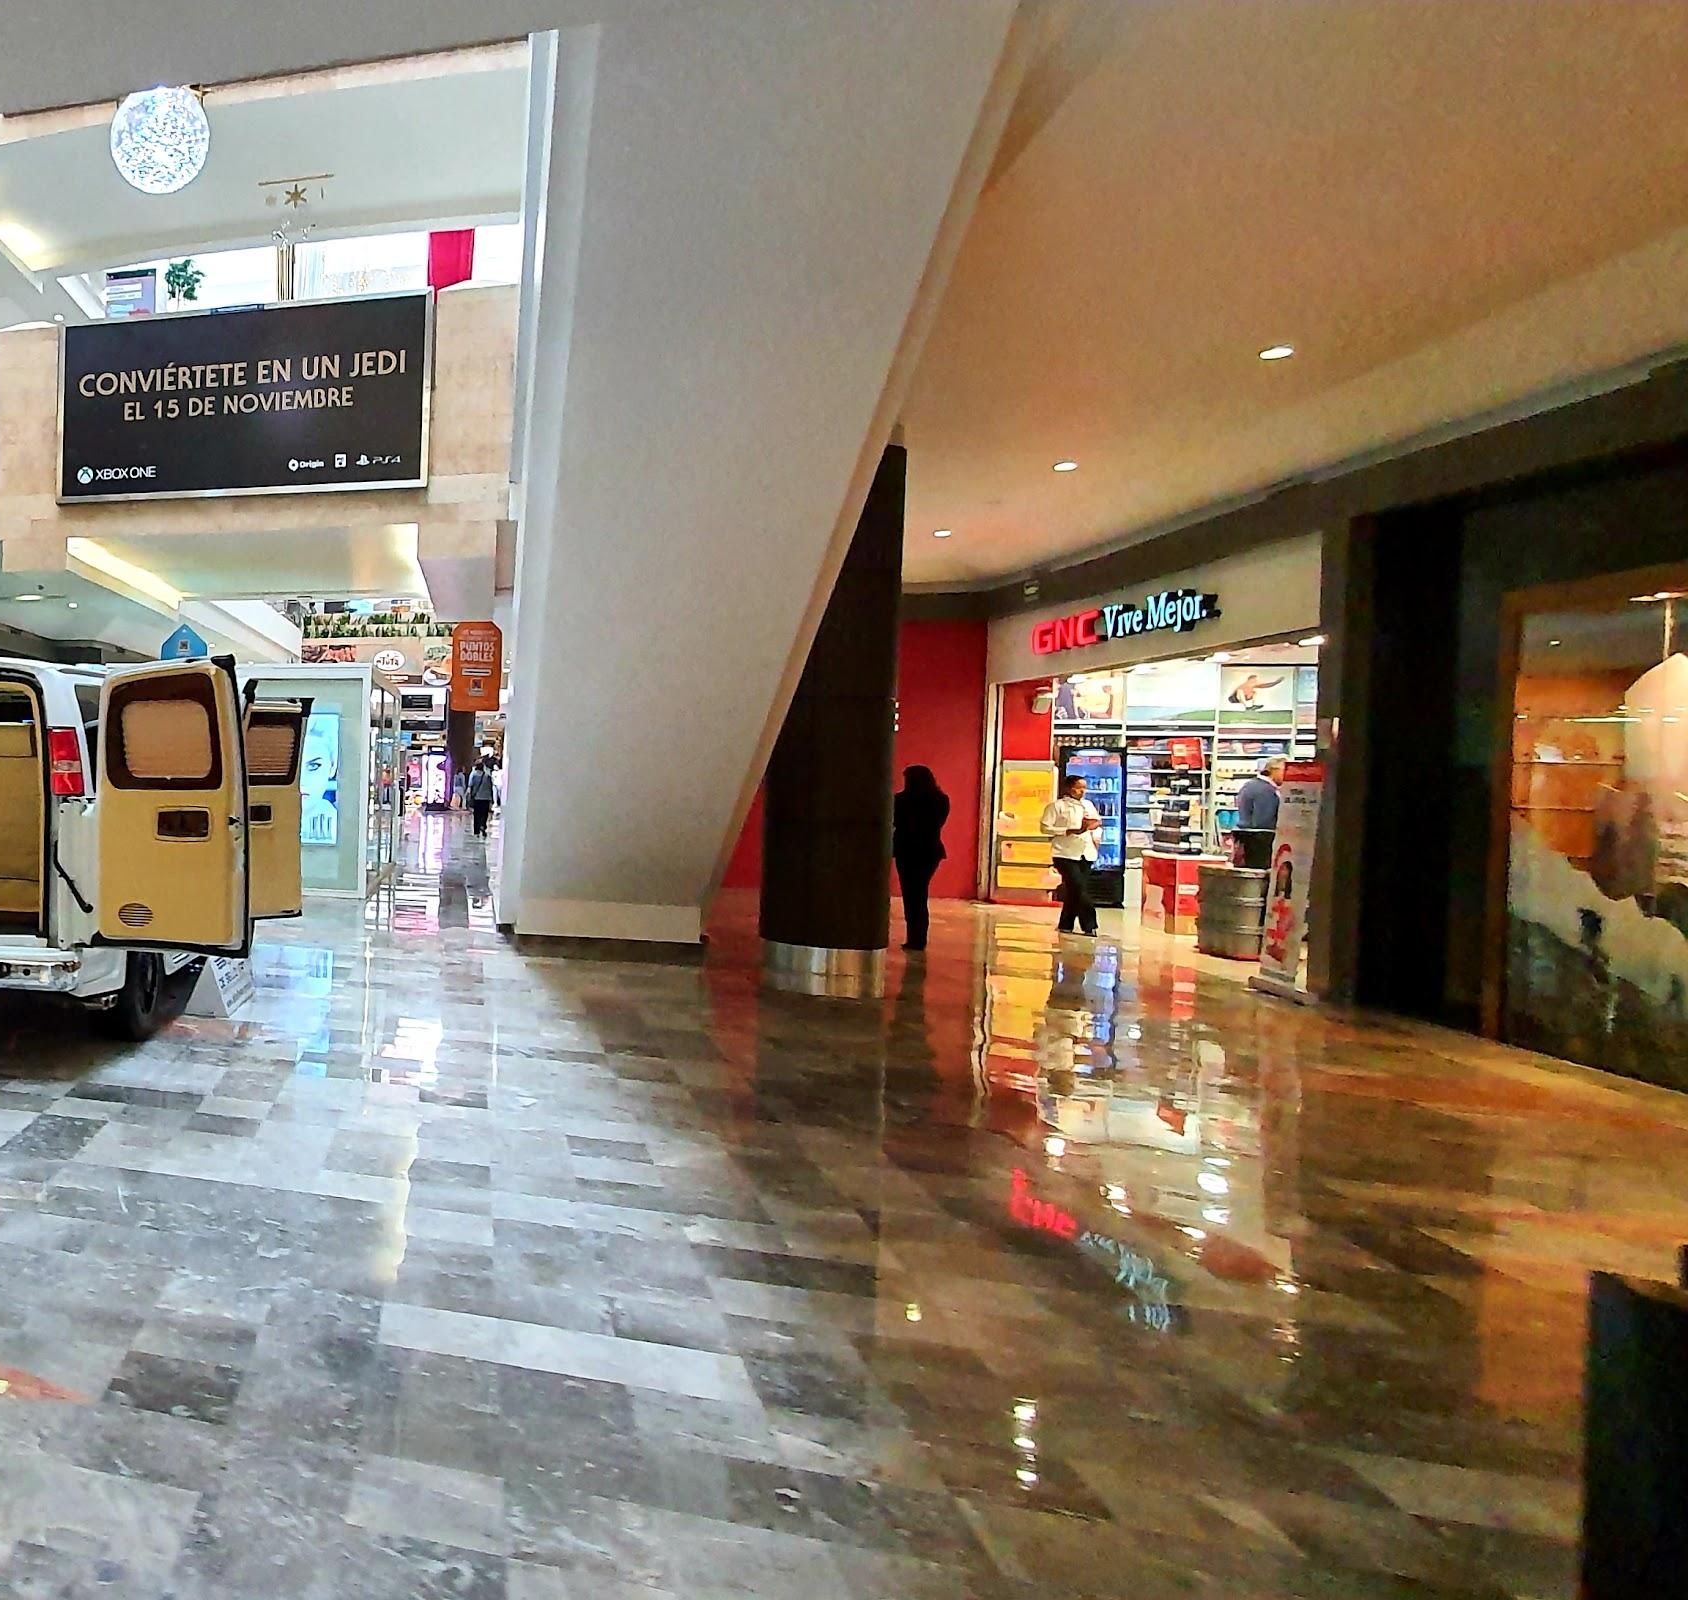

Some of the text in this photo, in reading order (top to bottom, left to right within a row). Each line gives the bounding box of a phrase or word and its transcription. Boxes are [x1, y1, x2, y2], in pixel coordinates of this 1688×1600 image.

[79, 350, 407, 397] CONVIÉRTETE EN UN JEDI
[124, 386, 354, 421] EL 15 DE NOVIEMBRE
[299, 455, 401, 469] Origin PS4
[95, 466, 157, 480] XBOX ONE
[1032, 589, 1208, 656] GNC Vive Mejor.
[459, 640, 495, 652] PUNTOS
[459, 651, 495, 662] DOBLES
